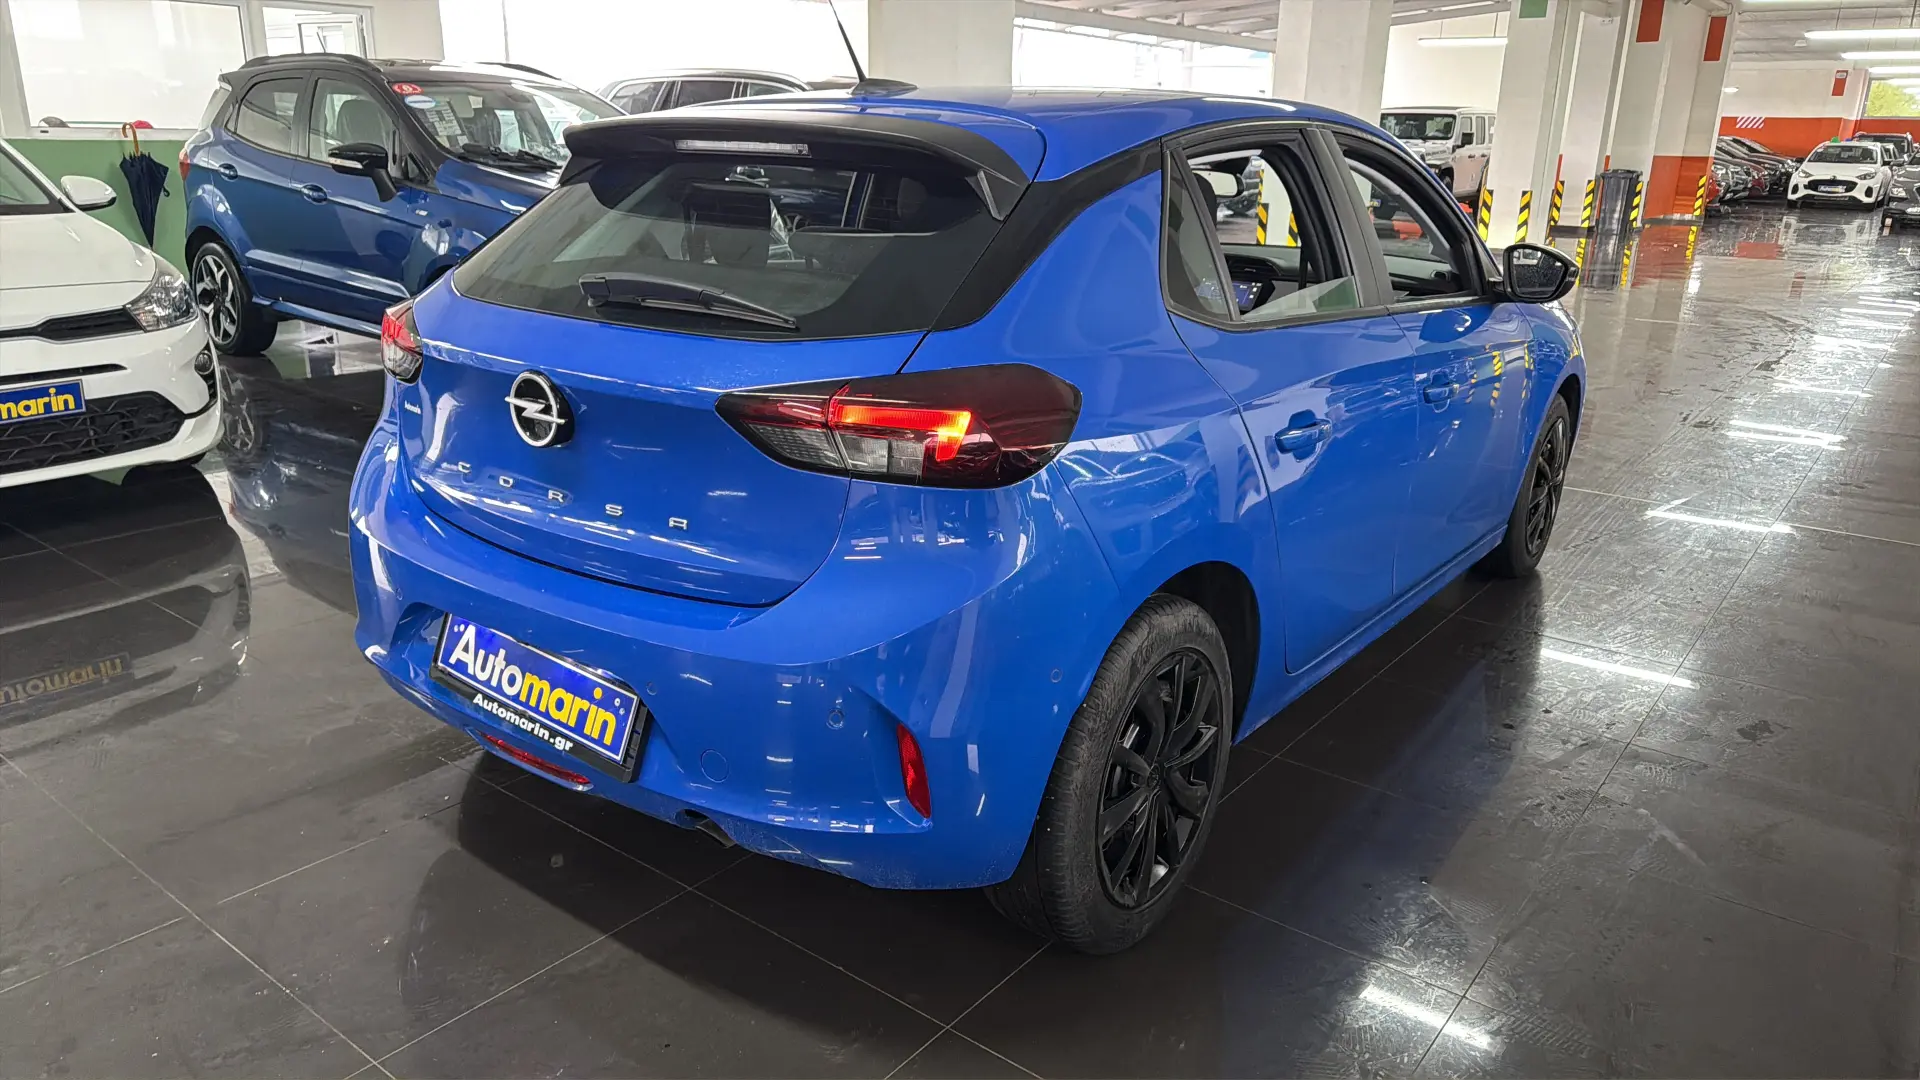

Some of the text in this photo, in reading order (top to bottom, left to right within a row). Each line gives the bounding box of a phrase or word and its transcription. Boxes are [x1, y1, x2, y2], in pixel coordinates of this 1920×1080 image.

[457, 461, 688, 530] CORSA
[448, 624, 617, 746] Automarin
[472, 693, 574, 752] Automarin.gr
